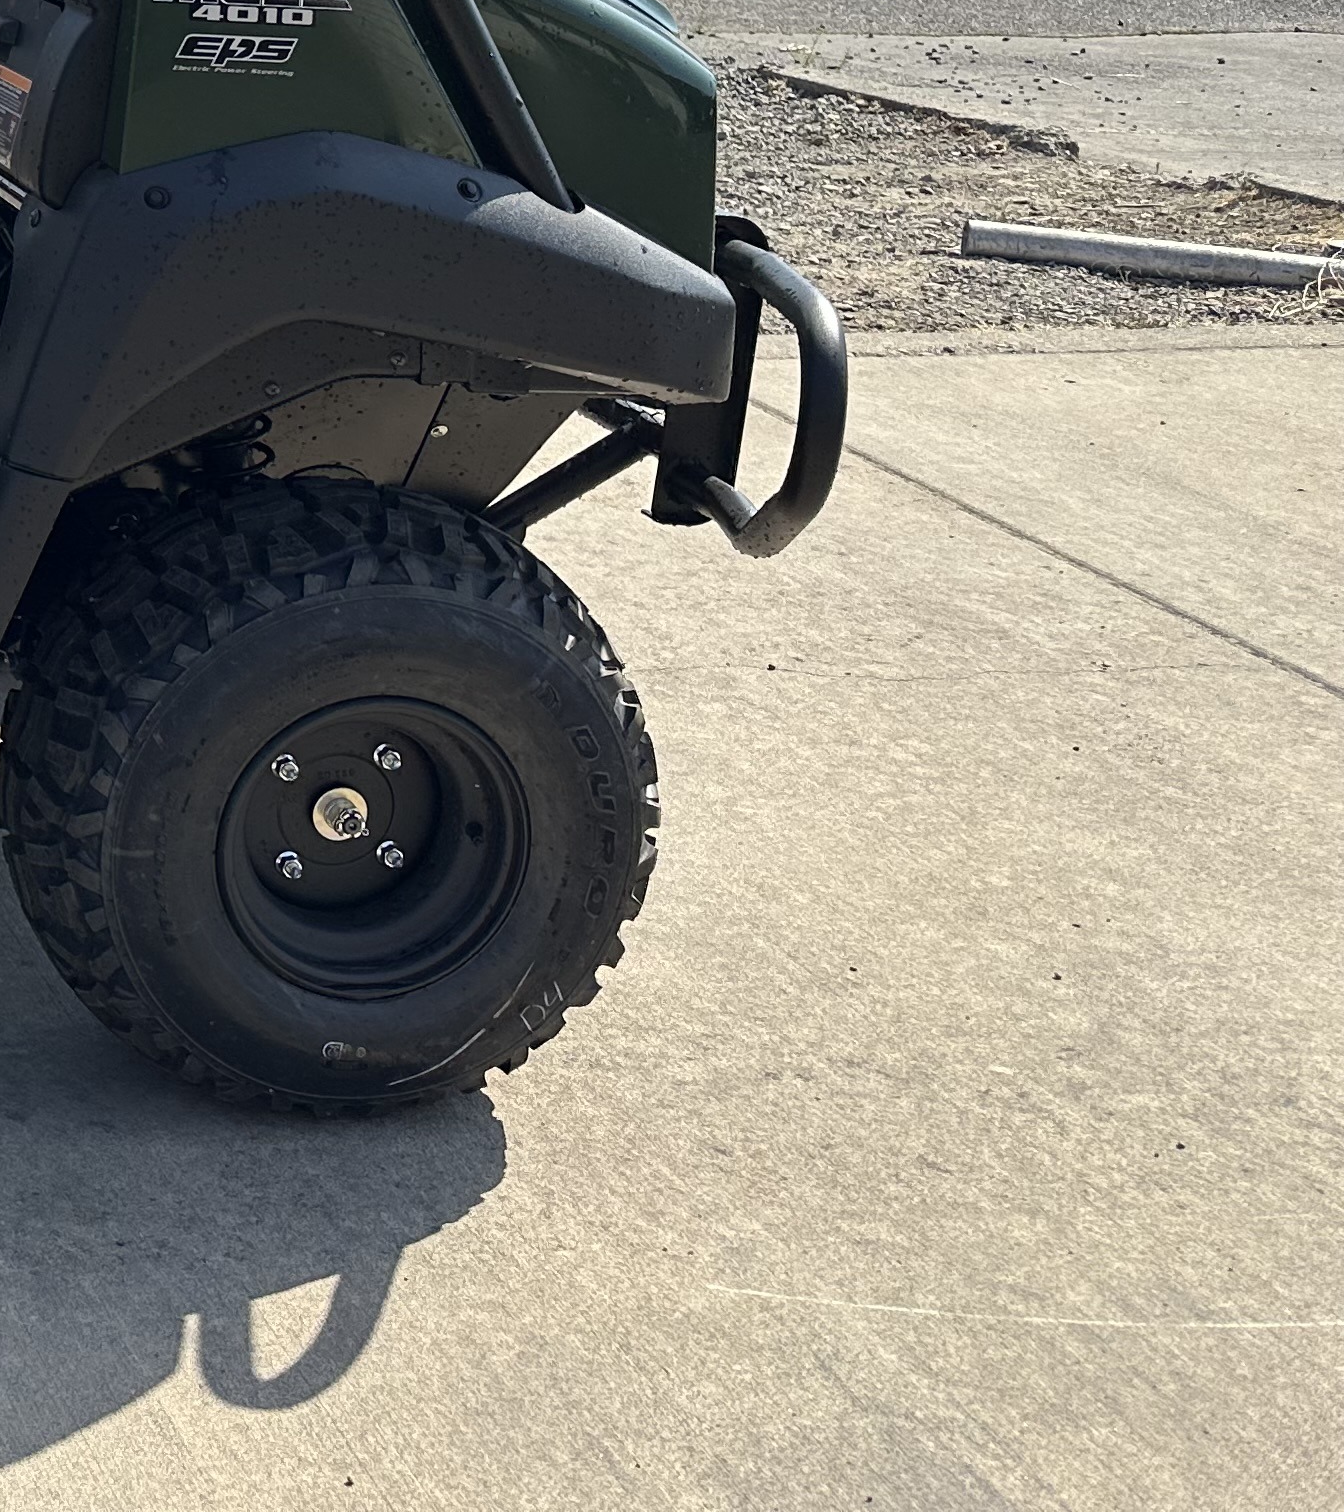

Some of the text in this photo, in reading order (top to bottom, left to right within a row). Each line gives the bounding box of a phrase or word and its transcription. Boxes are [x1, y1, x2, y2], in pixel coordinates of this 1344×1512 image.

[193, 4, 313, 26] 4010
[175, 33, 299, 68] EPS
[172, 64, 210, 73] Electric
[250, 68, 294, 77] Steering
